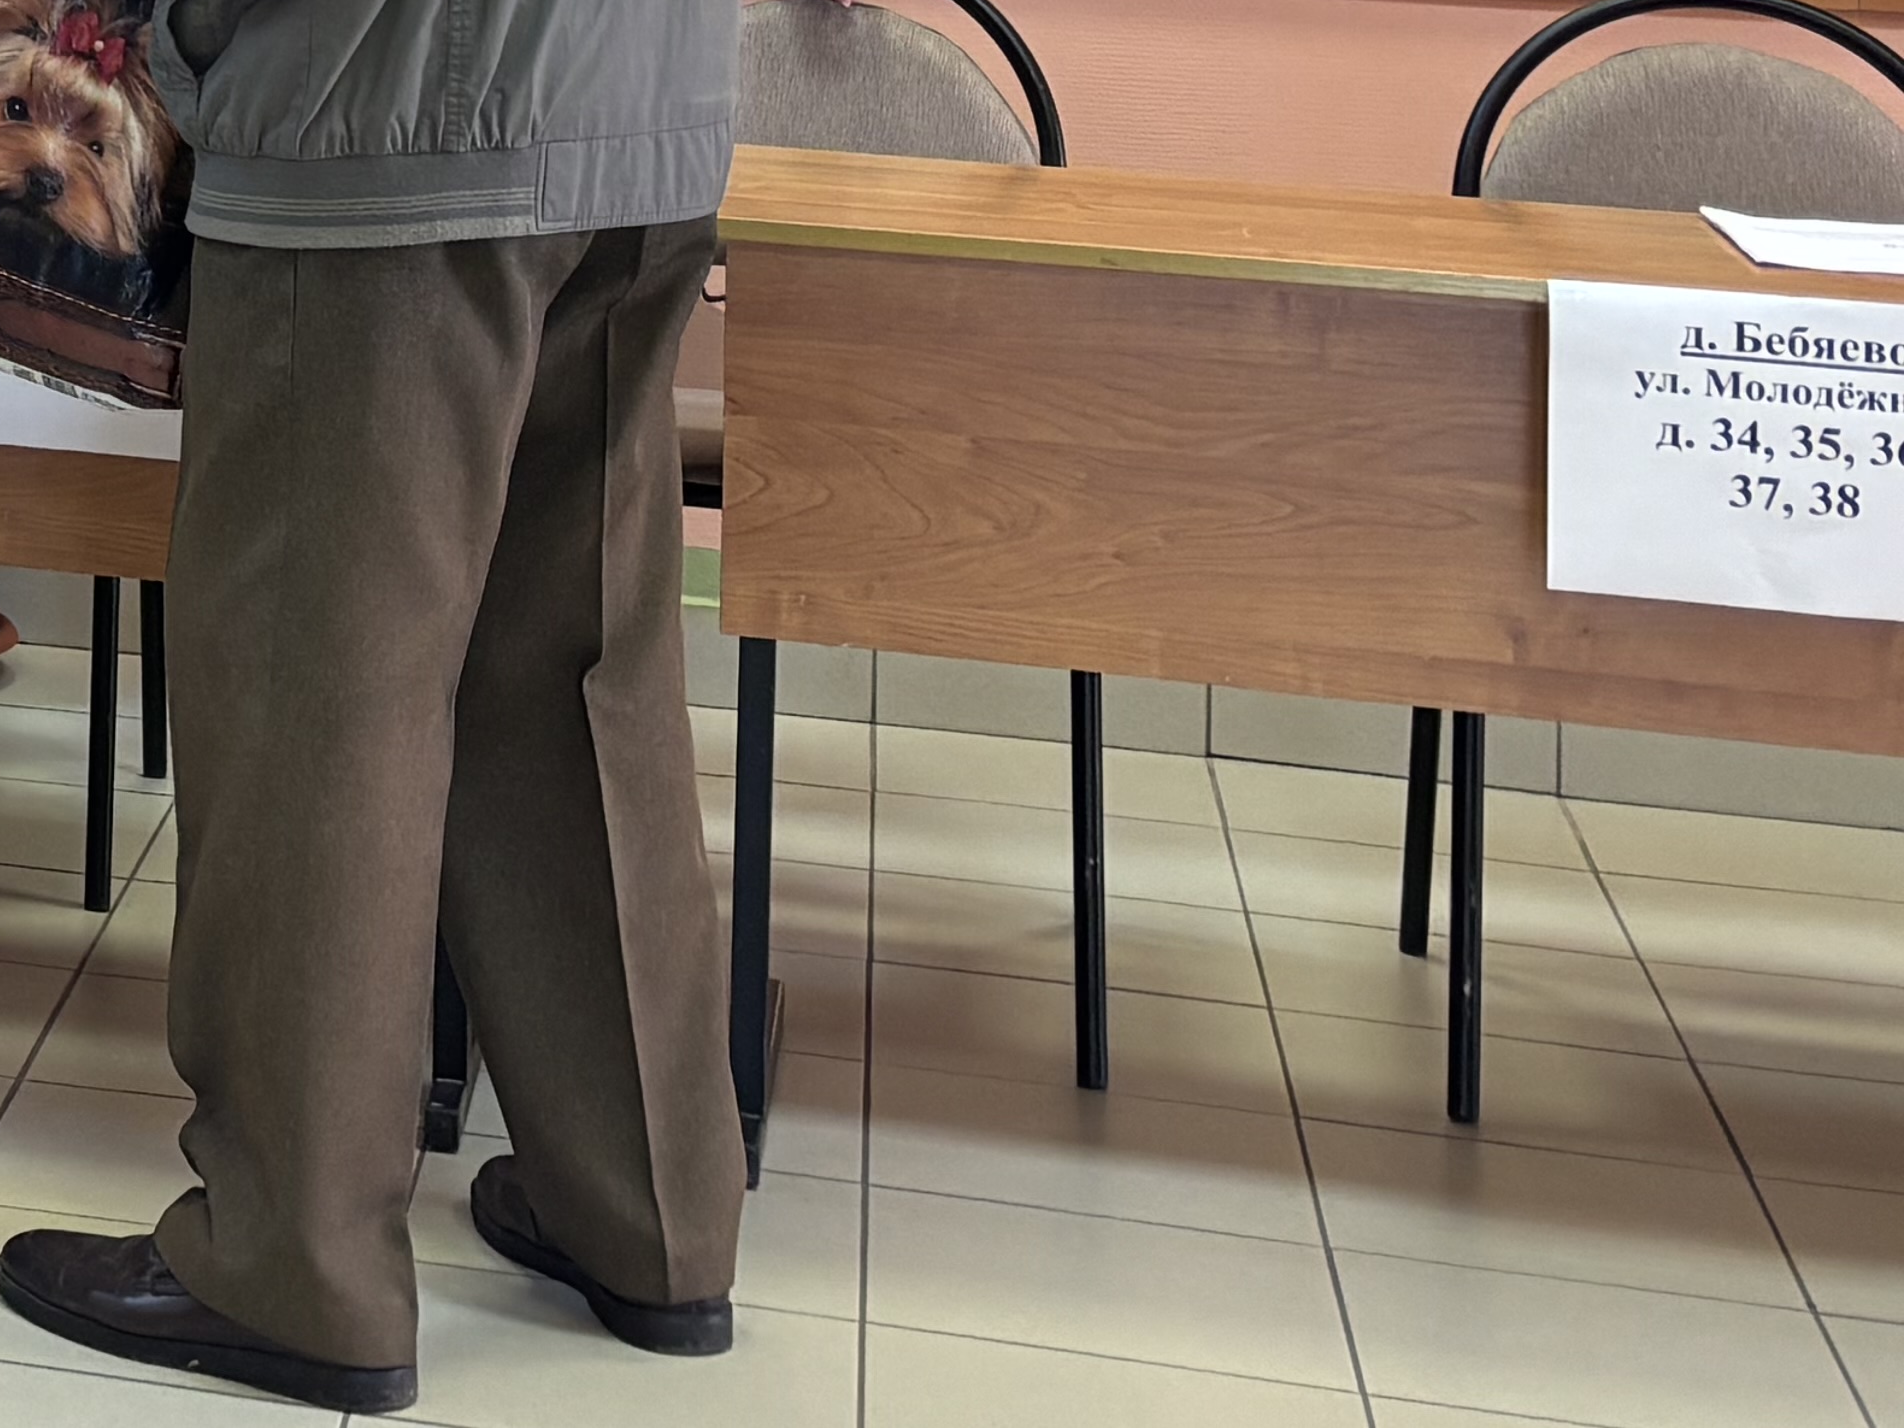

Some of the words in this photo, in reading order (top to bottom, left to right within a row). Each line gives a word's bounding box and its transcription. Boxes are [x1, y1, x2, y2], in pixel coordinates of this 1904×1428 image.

[1680, 326, 1717, 352] д.
[1634, 369, 1691, 399] ул.
[1655, 422, 1695, 450] д.
[1709, 417, 1775, 462] 34,
[1789, 425, 1855, 470] 35,
[1869, 432, 1904, 466] 3
[1729, 474, 1793, 519] 37,
[1808, 481, 1861, 519] 38
